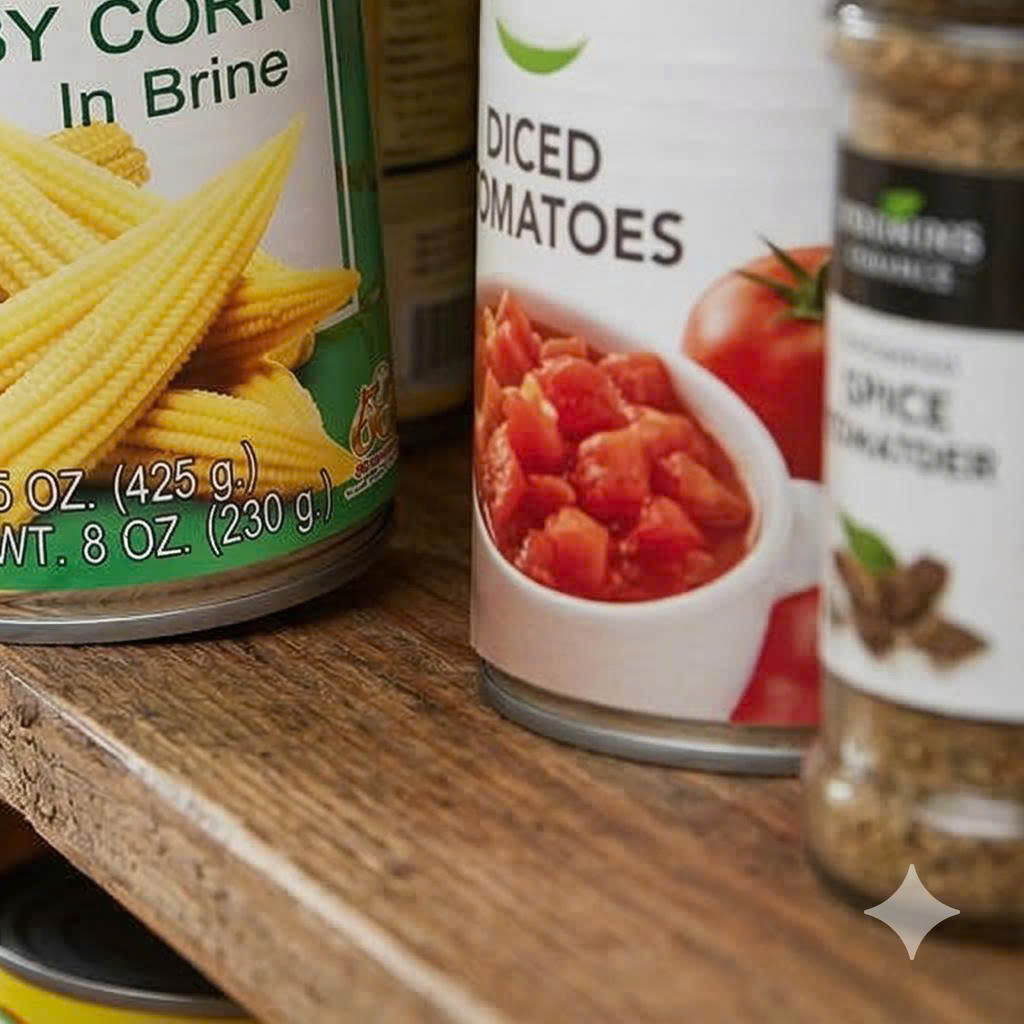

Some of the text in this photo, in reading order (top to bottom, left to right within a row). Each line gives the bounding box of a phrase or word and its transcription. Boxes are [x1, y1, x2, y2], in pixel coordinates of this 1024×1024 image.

[60, 49, 289, 129] In Brine
[487, 105, 602, 183] DICED
[479, 168, 684, 267] OMATOES
[26, 468, 96, 512] OZ.
[112, 457, 199, 515] (425
[211, 440, 257, 501] g.)
[82, 522, 108, 564] 8
[121, 515, 191, 559] OZ.
[206, 493, 283, 556] (230
[296, 467, 332, 533] g.)
